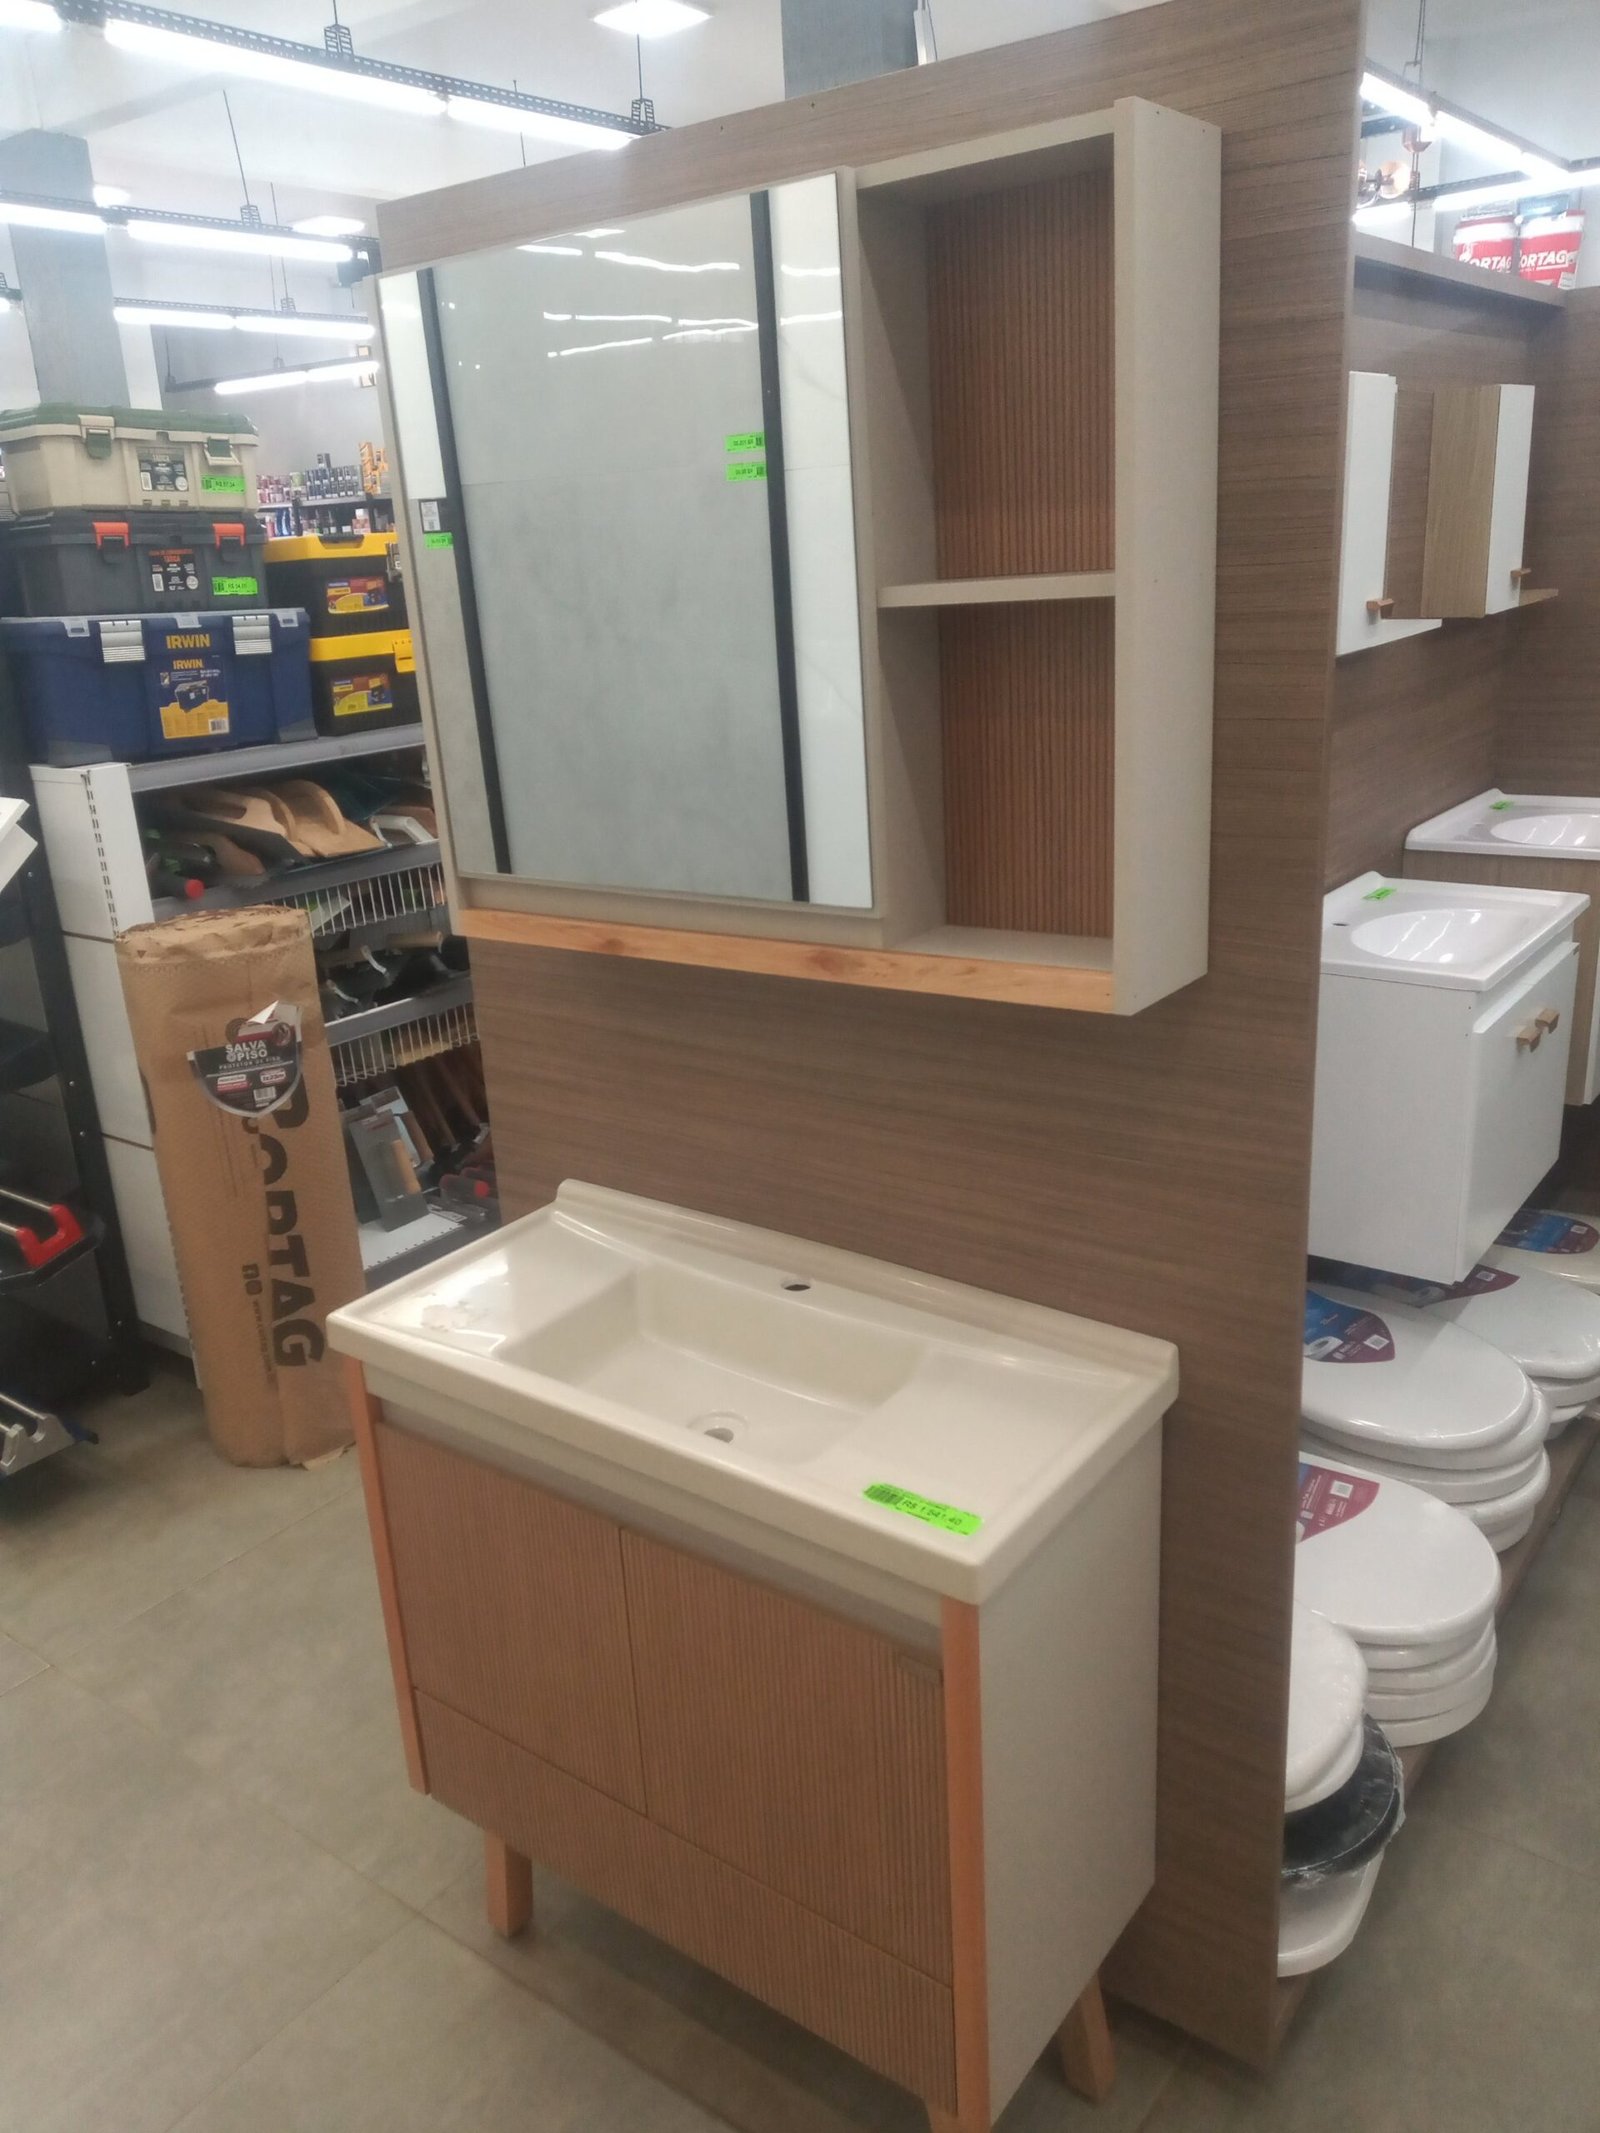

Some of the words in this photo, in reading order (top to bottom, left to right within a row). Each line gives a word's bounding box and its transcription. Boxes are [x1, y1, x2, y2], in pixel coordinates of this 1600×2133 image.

[1519, 250, 1568, 268] ORTAG
[165, 634, 211, 650] IRWIN
[172, 659, 204, 670] IRWIN
[225, 1041, 266, 1053] SALVA
